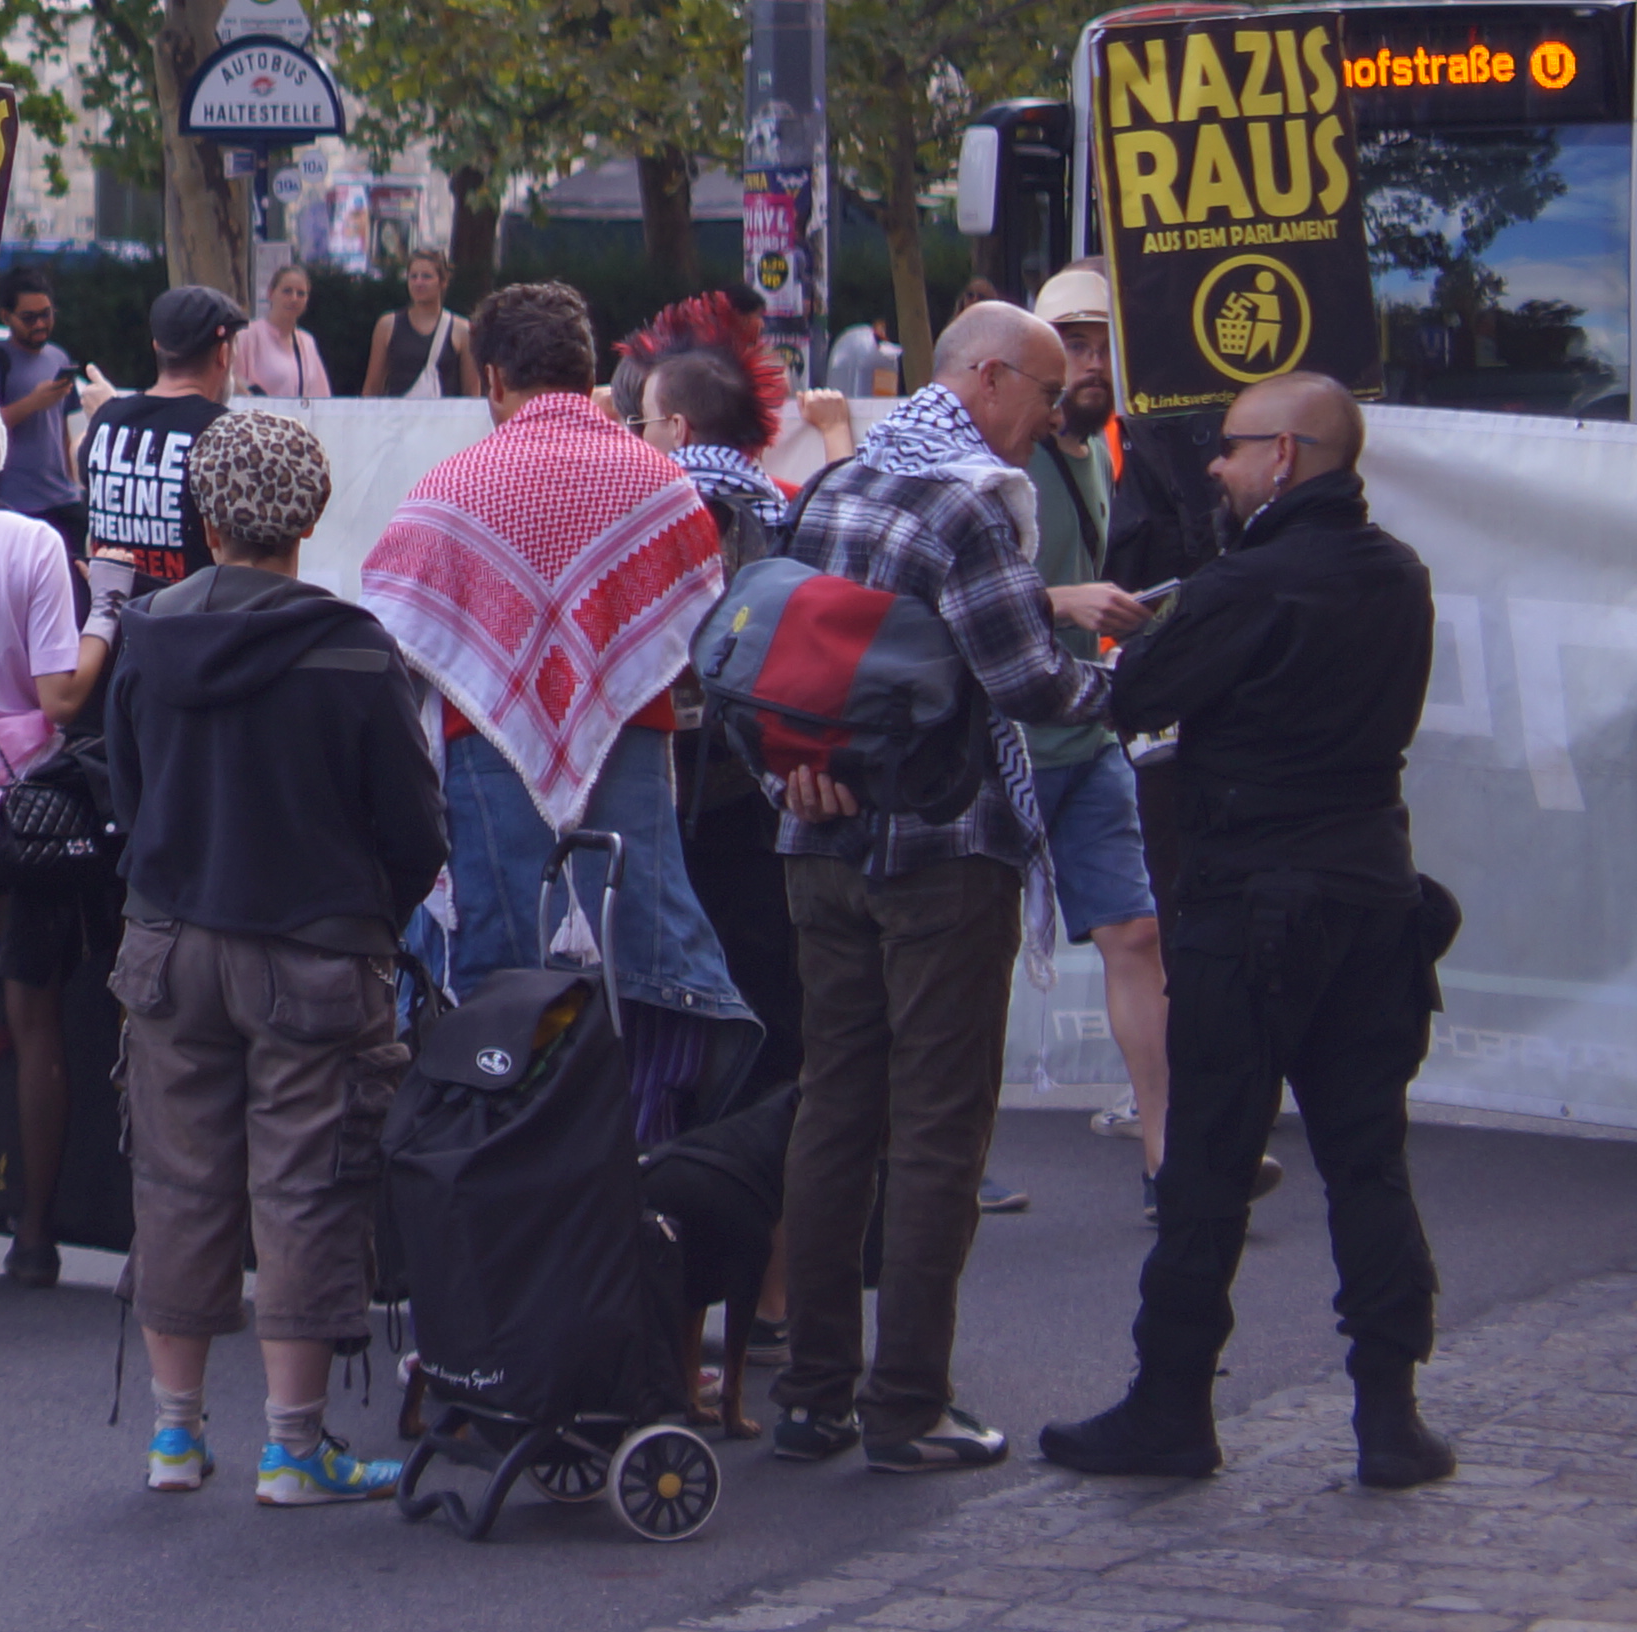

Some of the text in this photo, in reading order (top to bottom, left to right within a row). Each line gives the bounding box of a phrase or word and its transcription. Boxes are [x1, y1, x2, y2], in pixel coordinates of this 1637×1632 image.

[222, 51, 307, 86] AUTOBUS
[1106, 25, 1338, 128] NAZIS
[203, 104, 322, 123] HALTESTELLE
[1113, 115, 1350, 229] RAUS
[1143, 219, 1338, 254] AUS DEM PARLAMENT
[88, 422, 192, 480] ALLE
[88, 471, 183, 519] MEINE
[88, 510, 183, 547] FREUNDE
